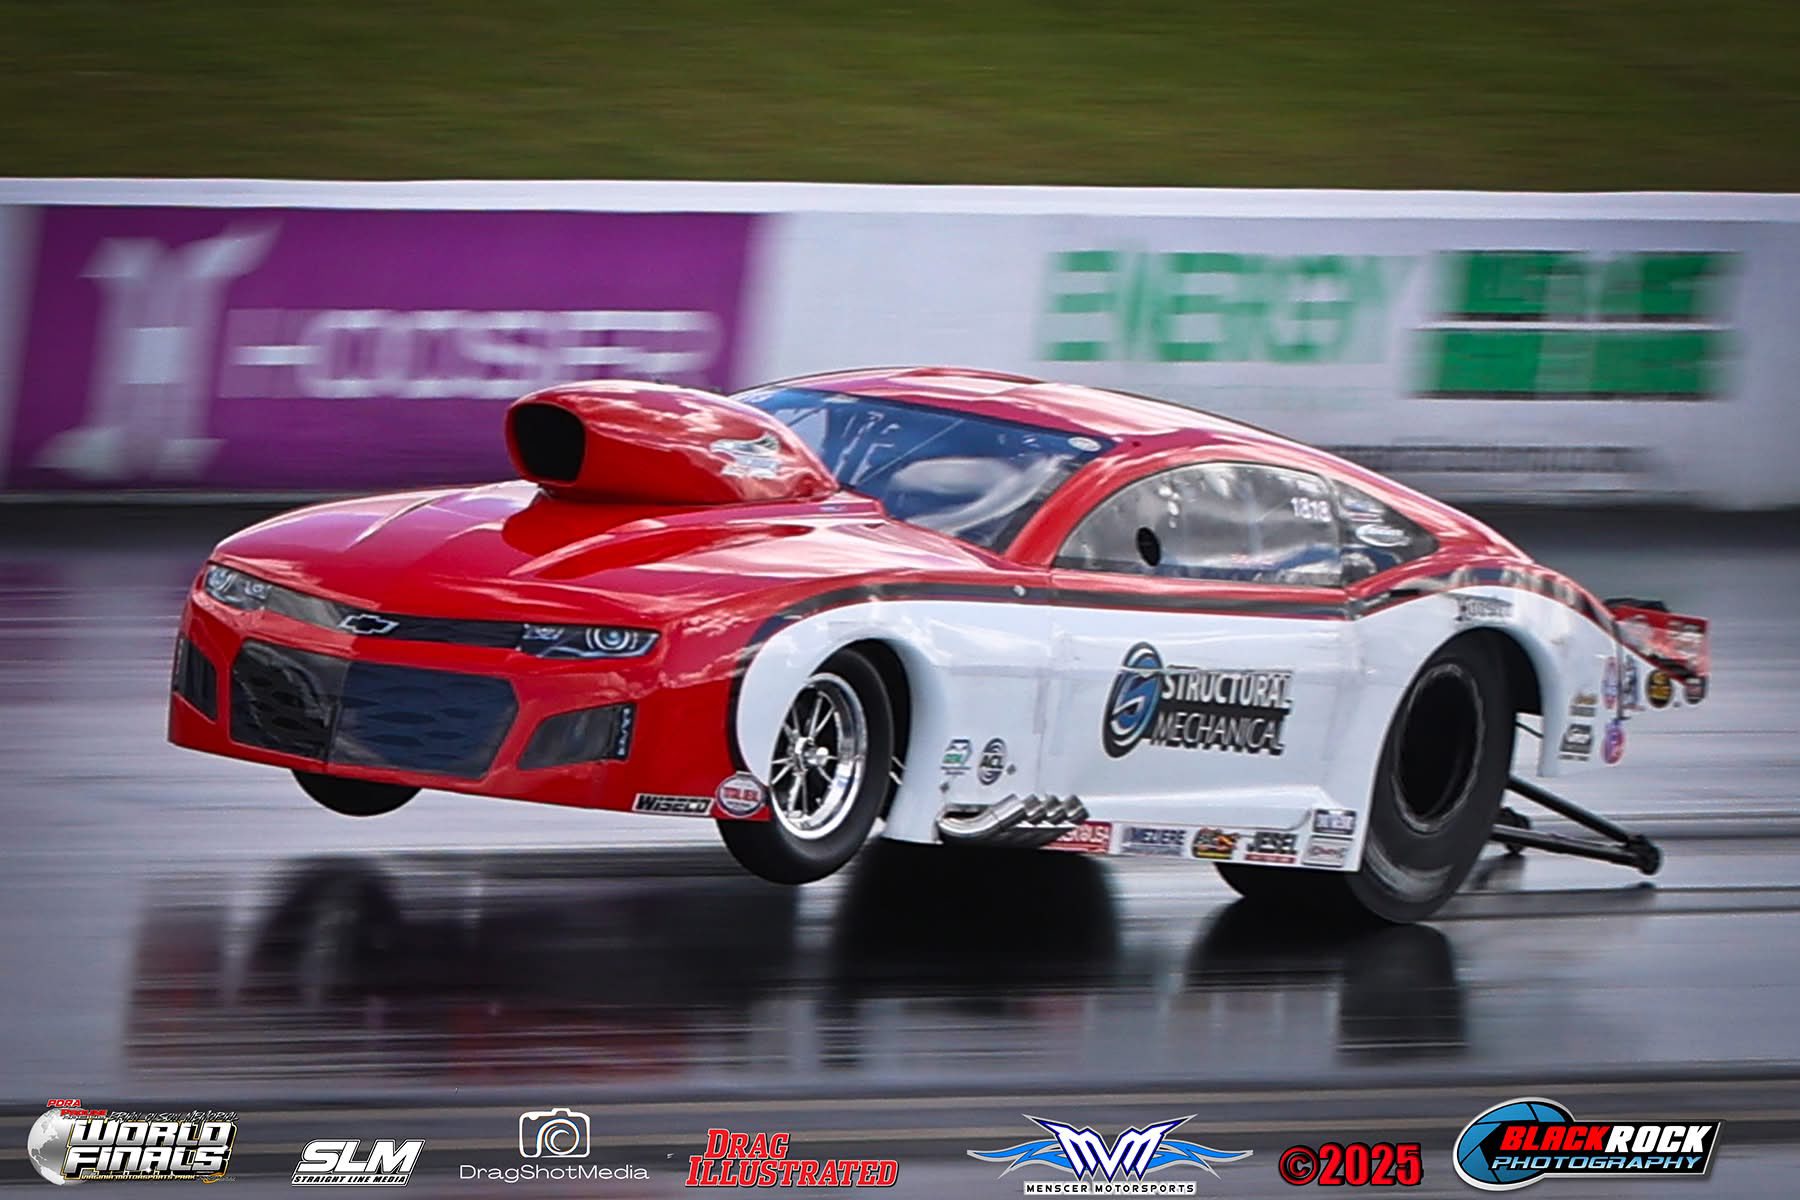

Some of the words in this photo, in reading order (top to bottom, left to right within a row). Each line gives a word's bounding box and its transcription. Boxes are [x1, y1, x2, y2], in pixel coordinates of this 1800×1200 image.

[1160, 669, 1294, 710] STRUCTURAL
[1151, 711, 1286, 753] MECHANICAL
[637, 795, 709, 813] WISECO
